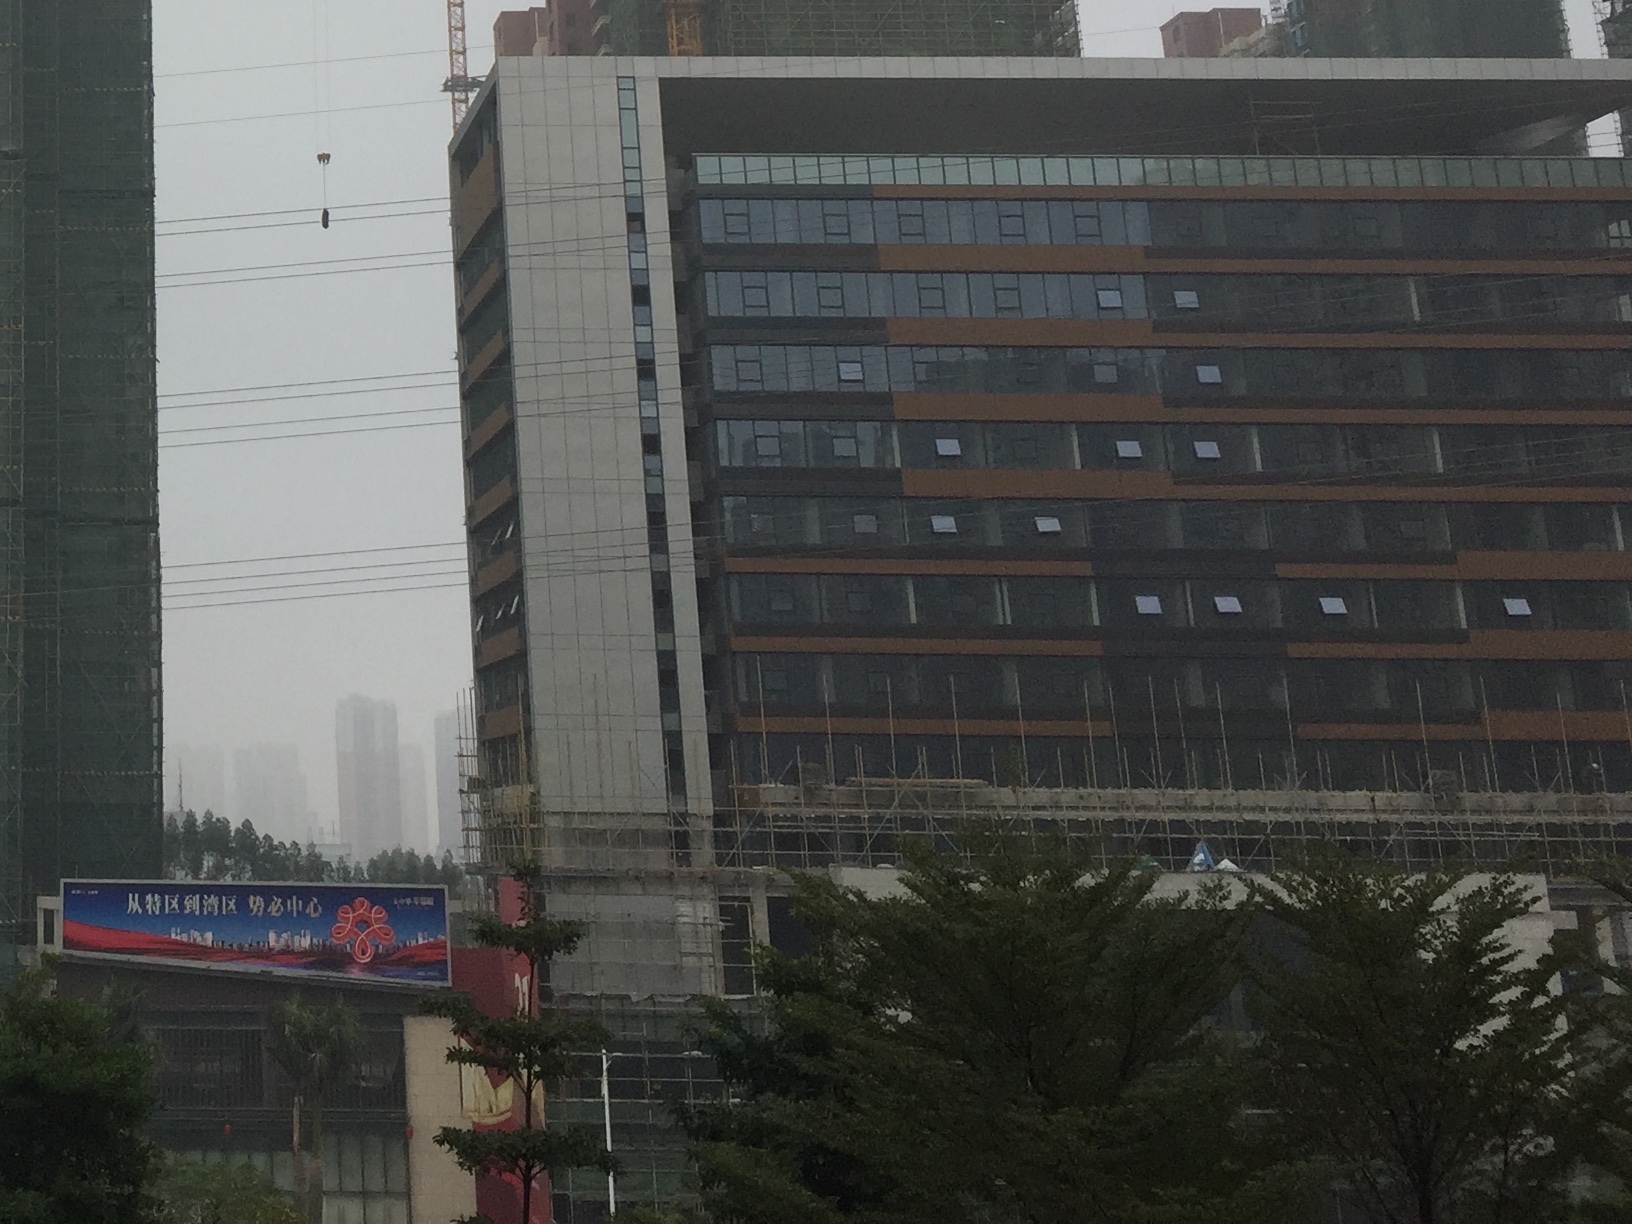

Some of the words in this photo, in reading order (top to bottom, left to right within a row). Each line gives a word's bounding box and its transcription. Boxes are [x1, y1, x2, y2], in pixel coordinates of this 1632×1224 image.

[127, 893, 237, 916] 从特区到湾区
[248, 895, 322, 918] 势必中心
